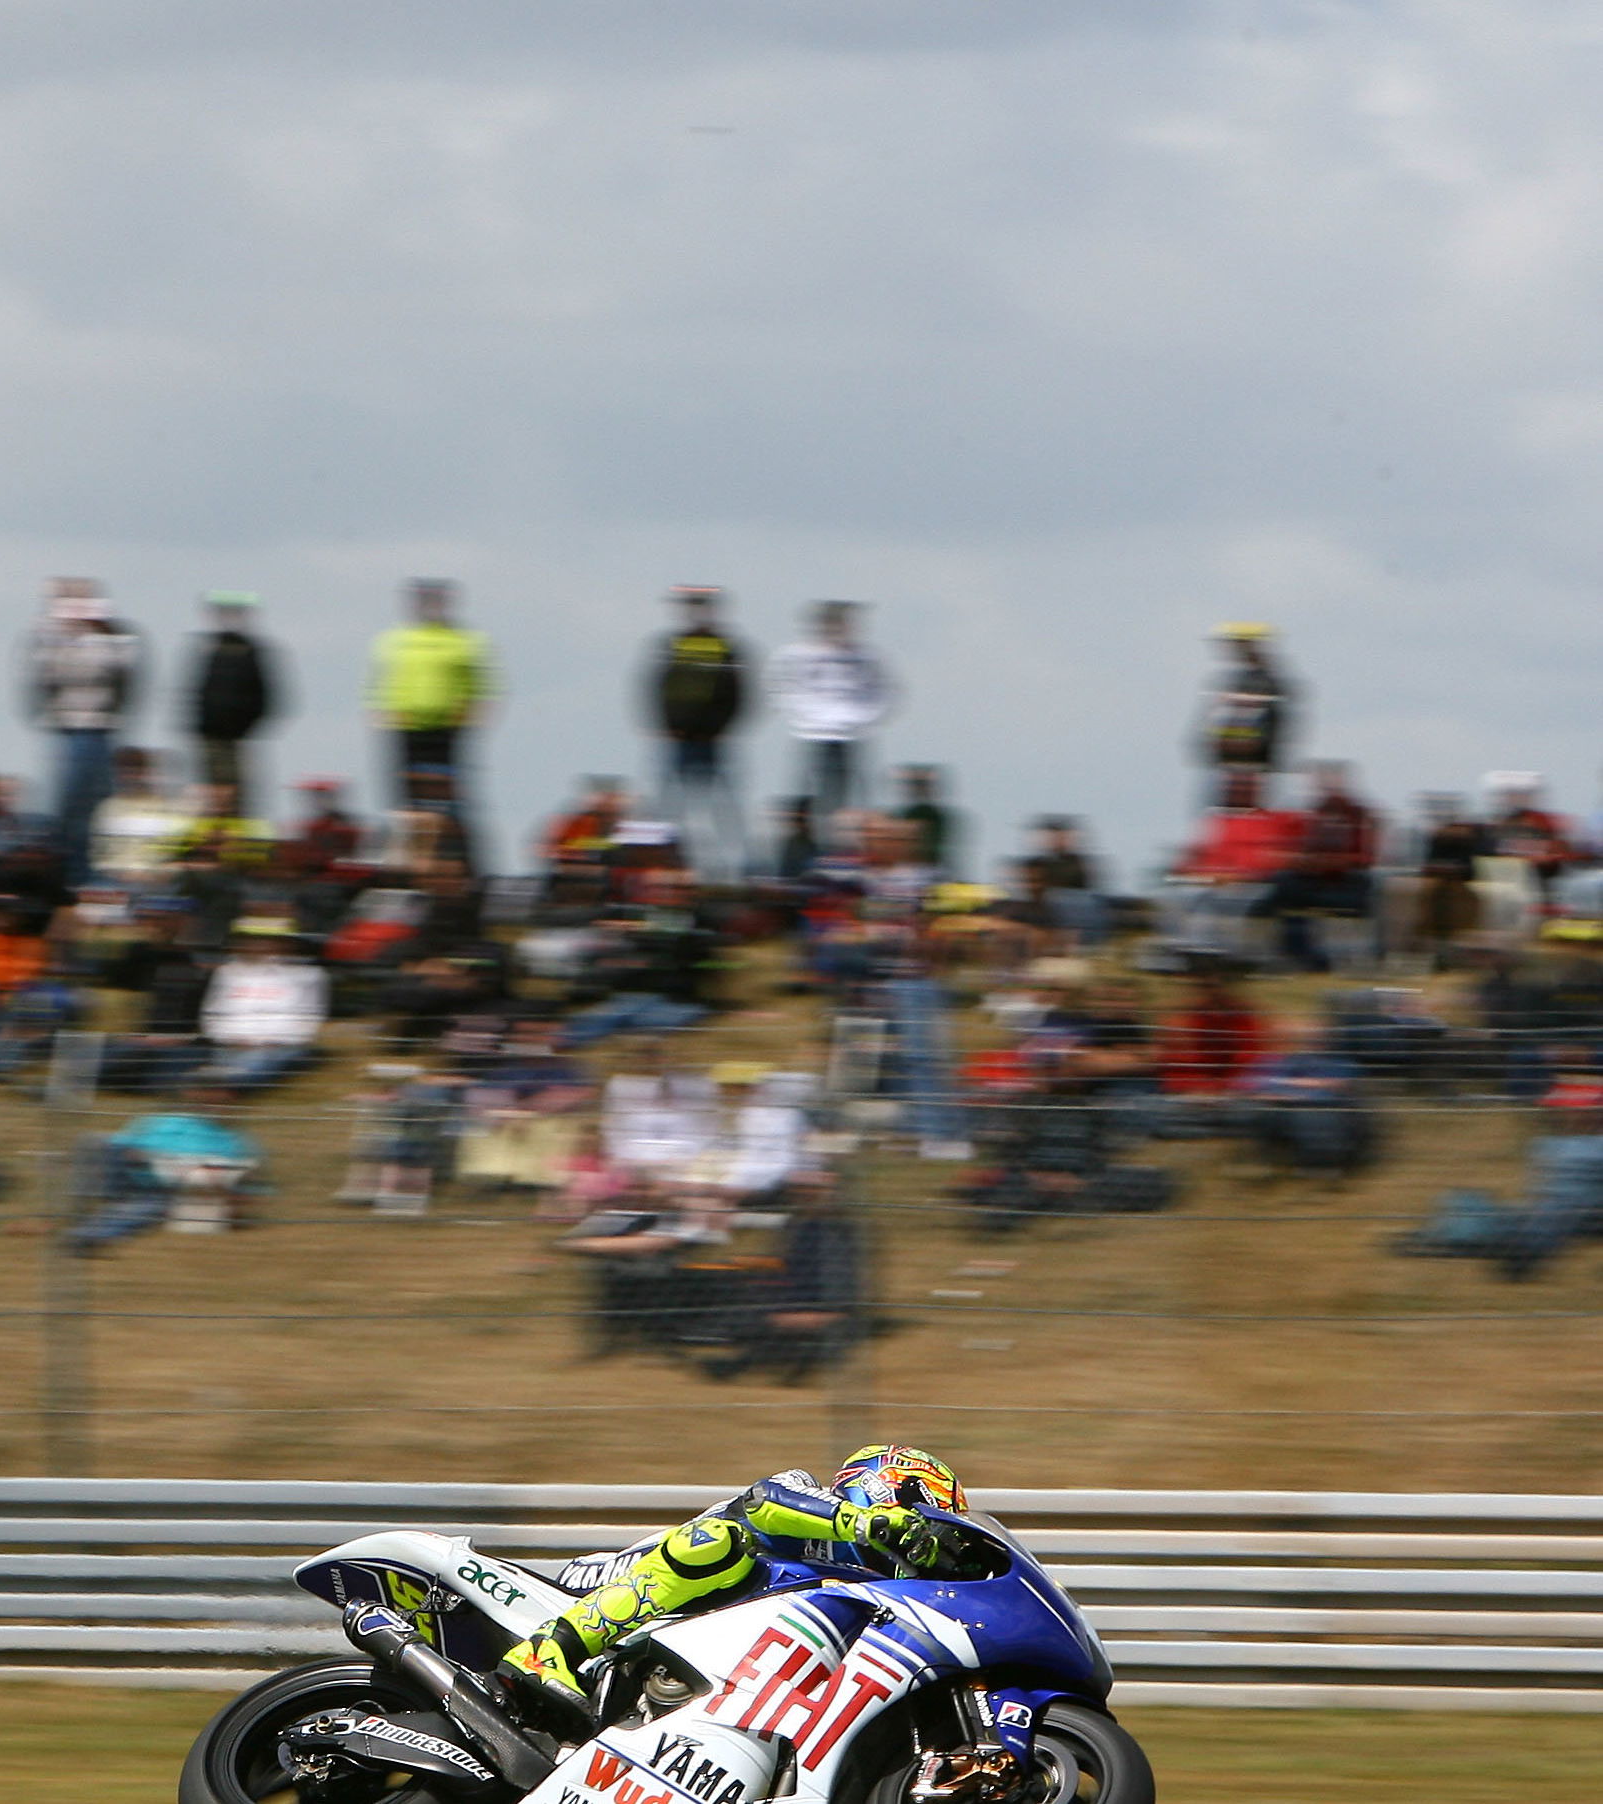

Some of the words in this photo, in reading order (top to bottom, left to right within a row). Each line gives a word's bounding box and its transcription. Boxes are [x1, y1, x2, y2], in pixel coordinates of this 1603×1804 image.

[330, 1568, 348, 1605] YAMAHA
[458, 1559, 527, 1607] acer
[704, 1626, 893, 1772] FIAT
[973, 1690, 995, 1727] brembo
[353, 1716, 495, 1781] BRIDGESTONE
